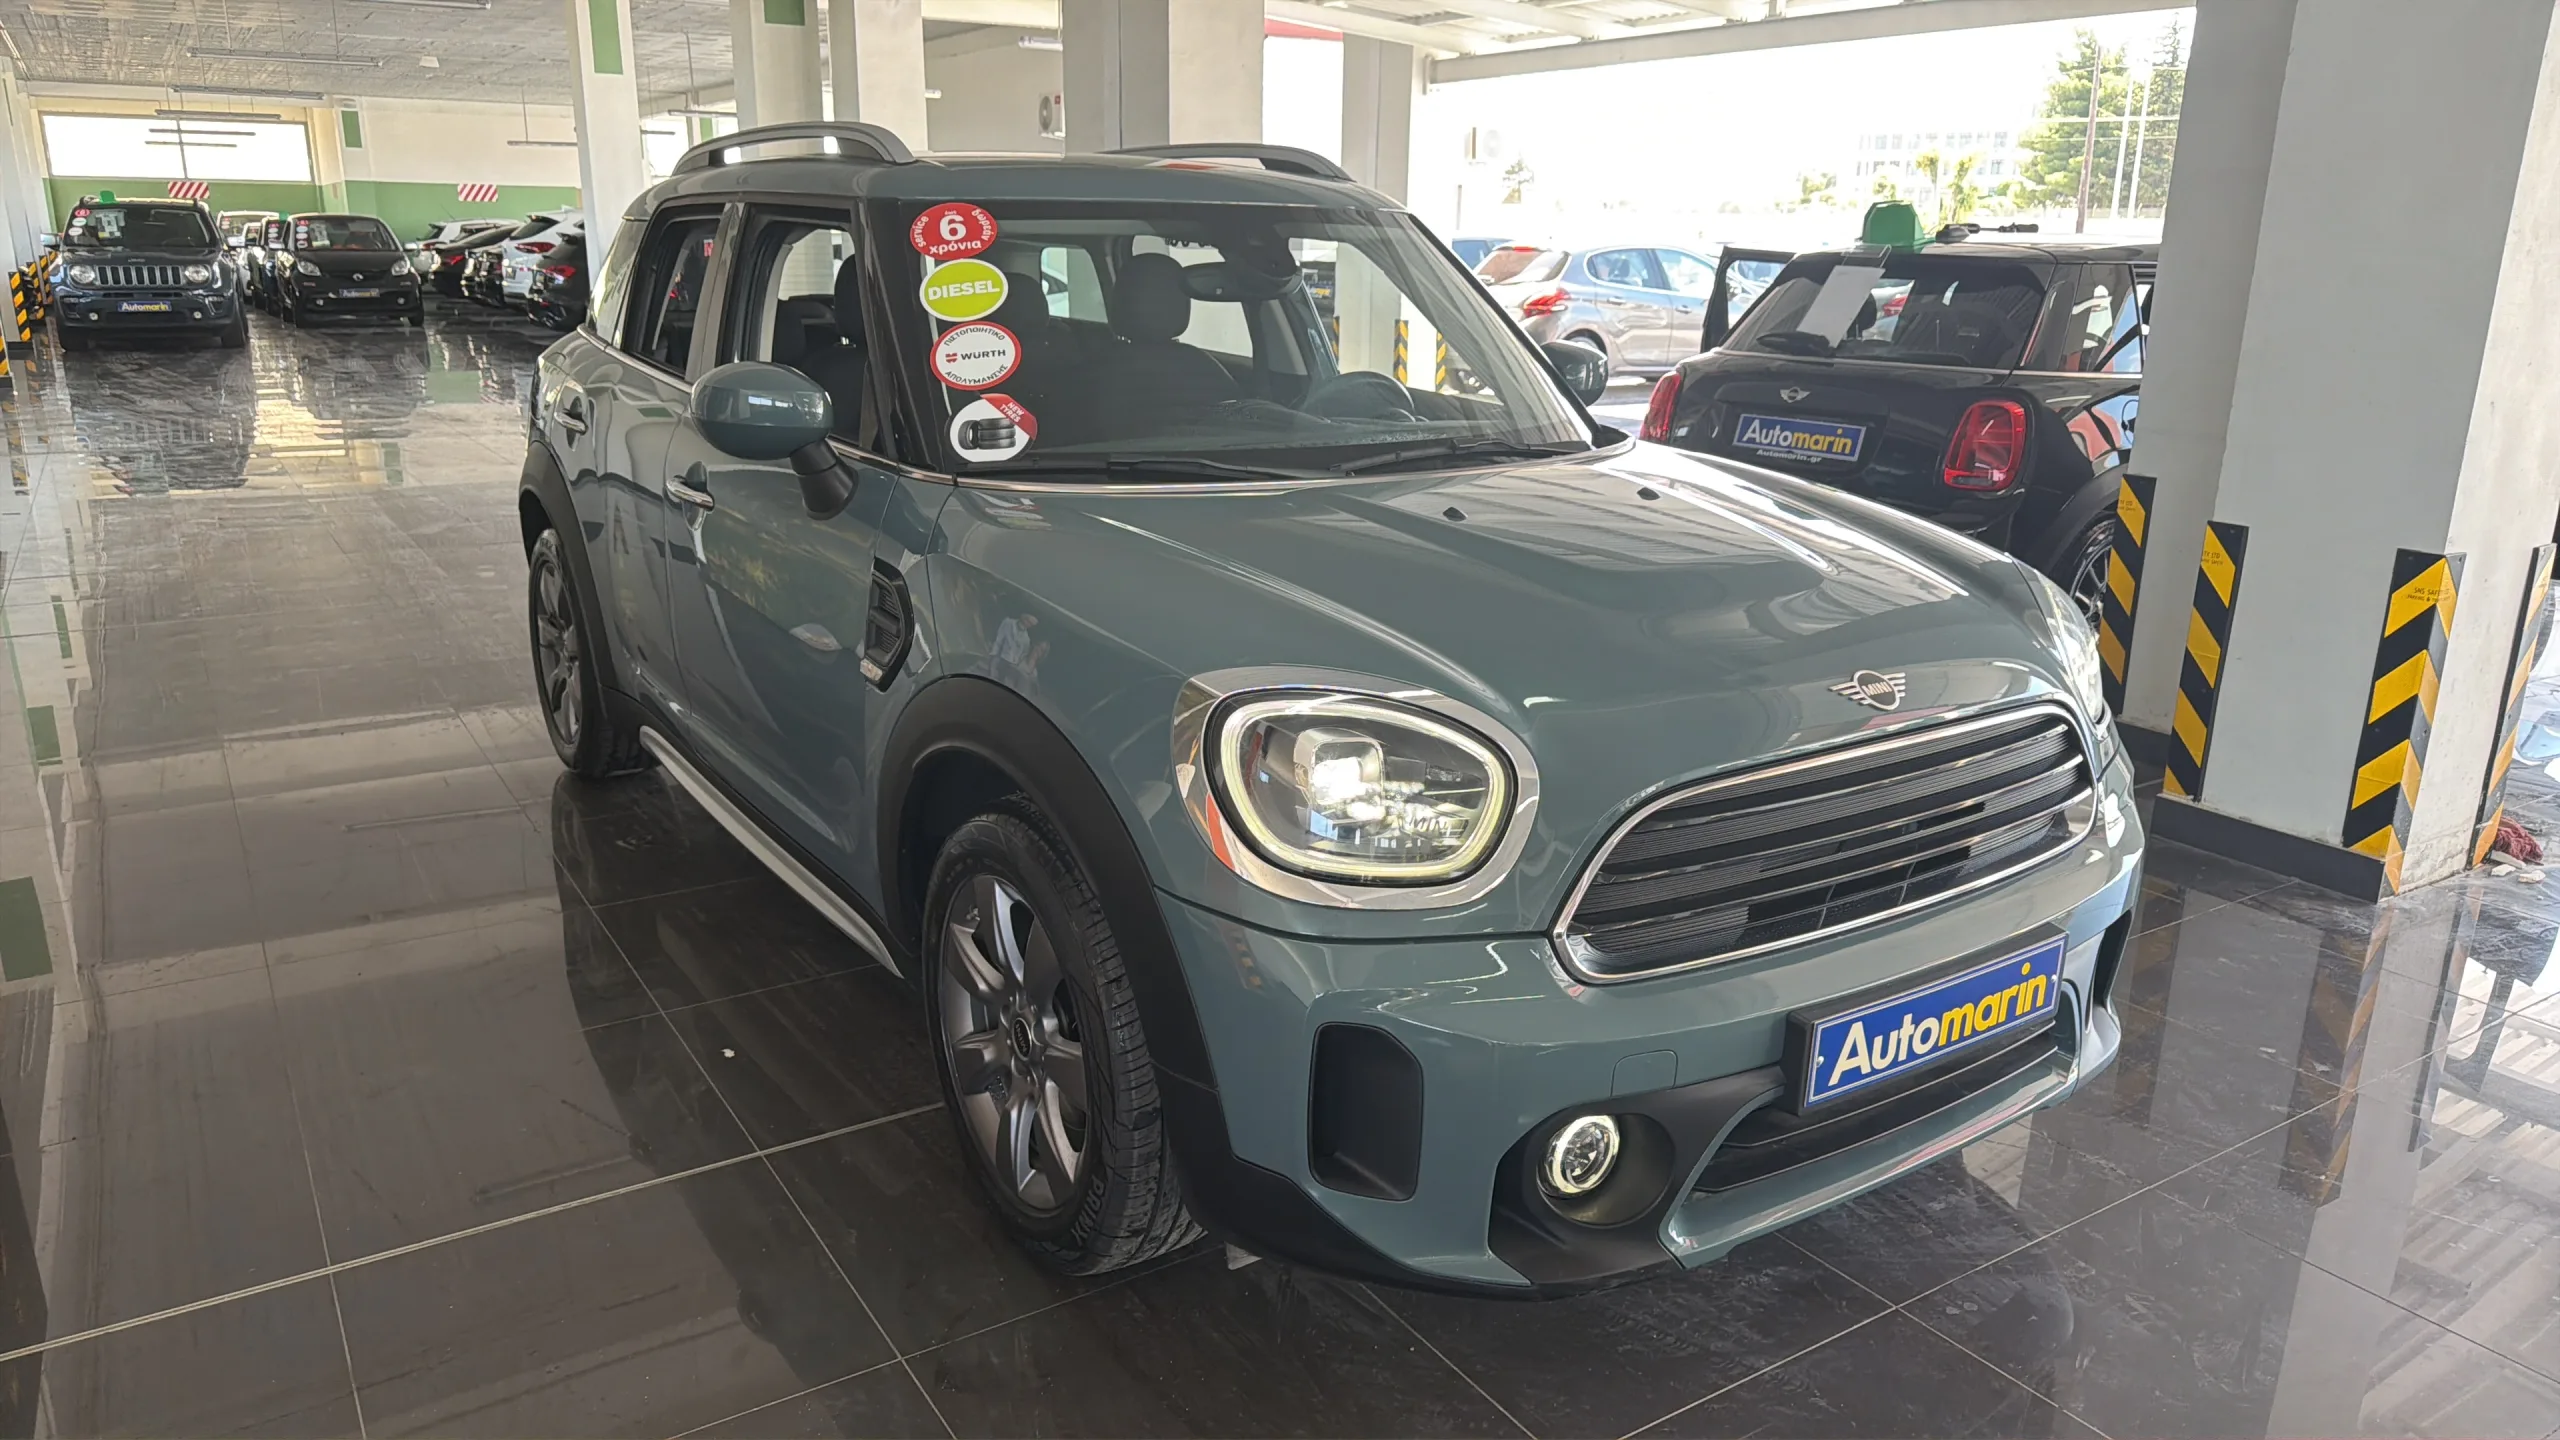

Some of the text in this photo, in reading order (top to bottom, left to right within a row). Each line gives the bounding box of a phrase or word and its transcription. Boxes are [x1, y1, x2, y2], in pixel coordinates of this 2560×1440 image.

[913, 215, 929, 247] service
[940, 214, 966, 241] 6
[971, 208, 994, 241] δωρεάν
[929, 240, 982, 255] χρόνια
[928, 280, 1000, 301] DIESEL
[121, 302, 169, 312] Automarin
[944, 327, 1006, 346] ΠΙΣΤΟΠΟΙΗΤΙΚΟ
[945, 364, 1008, 384] ΑΠΟΛΥΜΑΝΣΗΣ
[1000, 403, 1021, 422] TYRES
[1007, 401, 1025, 416] NEW
[1742, 419, 1852, 454] Automarin
[1861, 681, 1893, 696] MINI
[1828, 962, 2047, 1087] Automarin
[1070, 1174, 1104, 1248] PRINX
